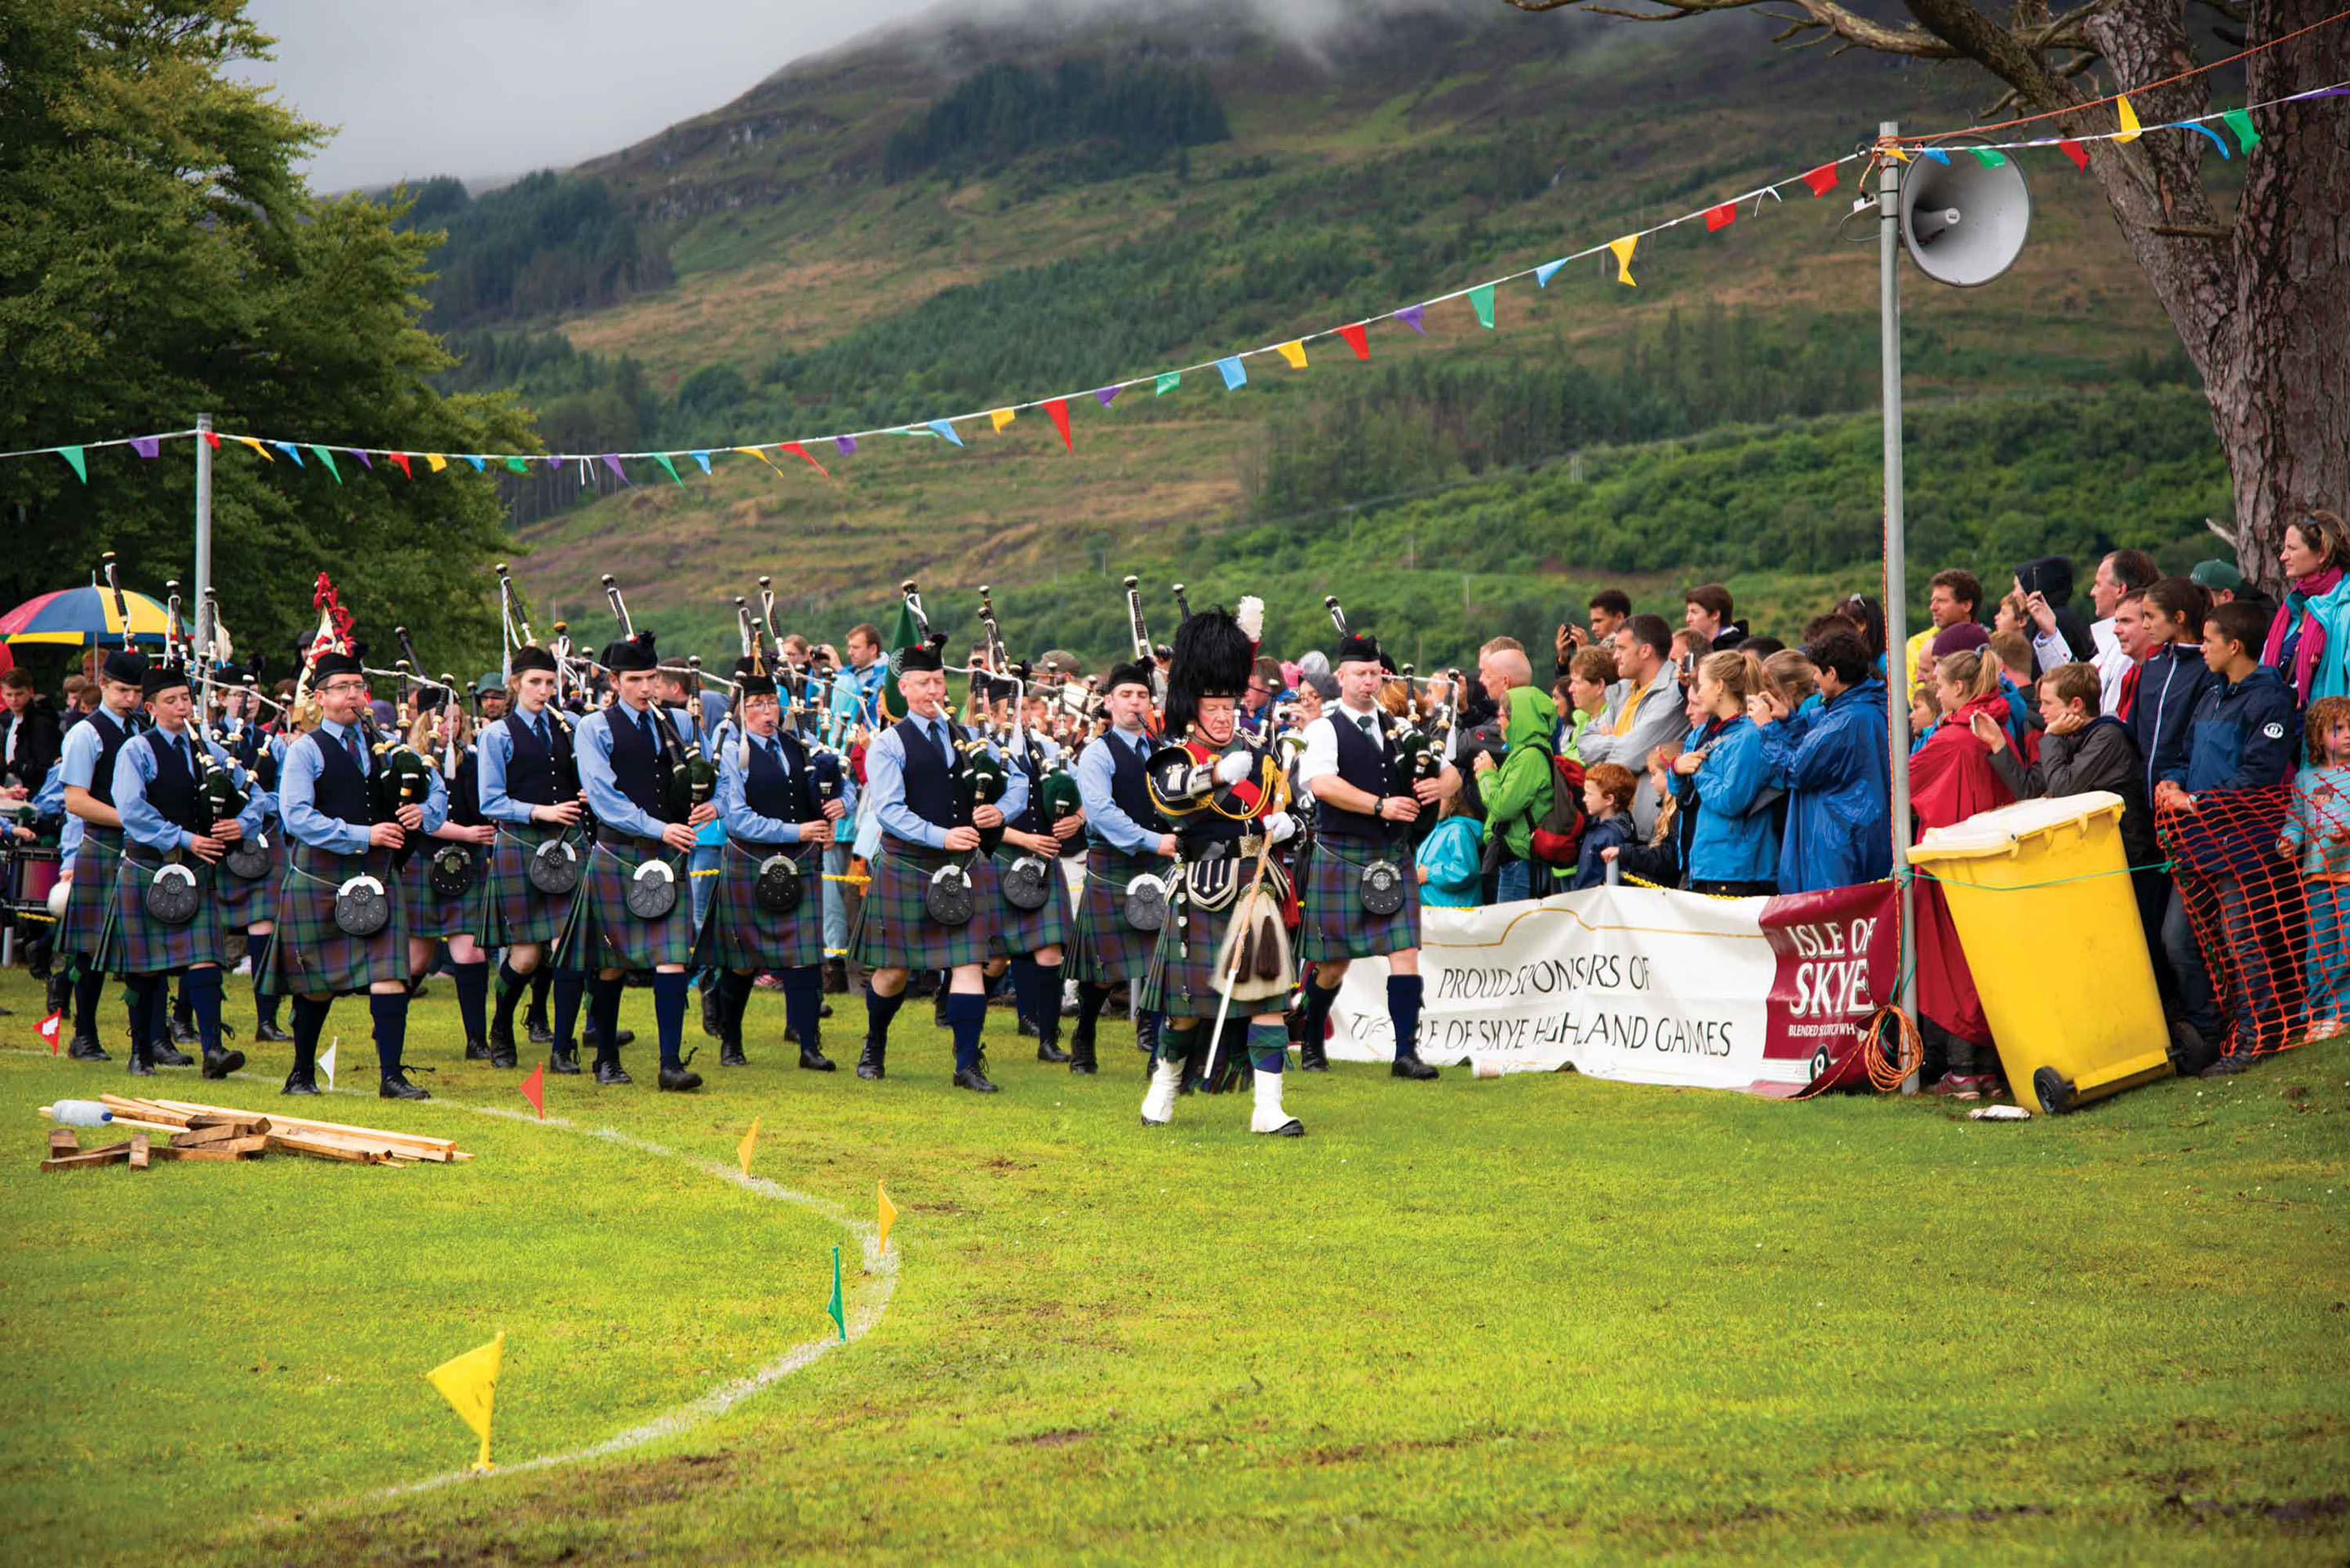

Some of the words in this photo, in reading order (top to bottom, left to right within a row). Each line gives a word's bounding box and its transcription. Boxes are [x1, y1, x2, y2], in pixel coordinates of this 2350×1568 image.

[1785, 922, 1845, 957] ISLE
[1851, 917, 1877, 954] OF
[1438, 968, 1513, 998] PROUD
[1510, 954, 1621, 994] SPONSRS
[1629, 955, 1650, 990] OF
[1789, 959, 1876, 1019] SKYE
[1445, 1019, 1474, 1049] OF
[1476, 1019, 1529, 1051] SKYE
[1533, 1012, 1647, 1048] HGHAND
[1655, 1017, 1732, 1056] GAMES
[1789, 1024, 1818, 1037] BLENDED
